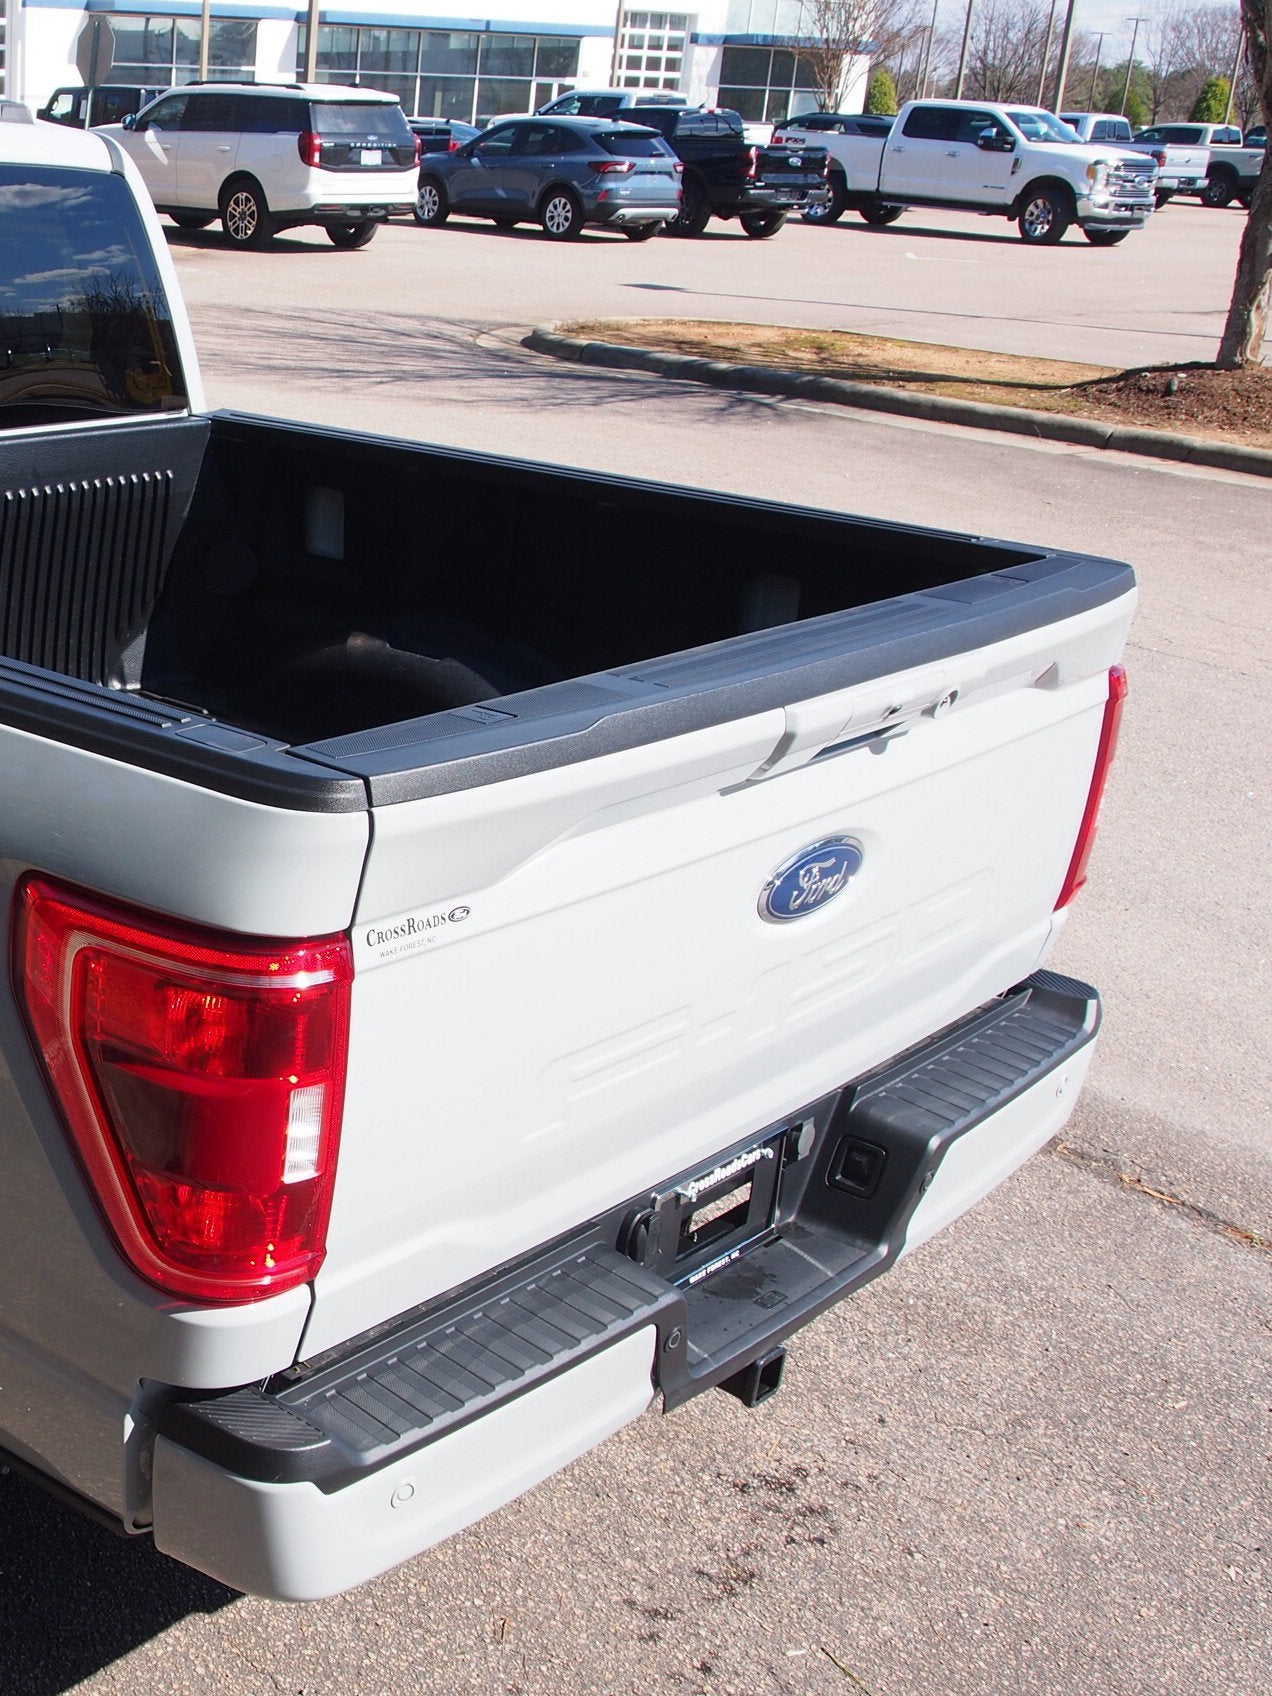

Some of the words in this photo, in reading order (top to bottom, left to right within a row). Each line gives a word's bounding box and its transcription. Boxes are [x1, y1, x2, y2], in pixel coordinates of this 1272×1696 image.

[788, 856, 848, 911] Ford
[379, 946, 399, 958] WAKE
[427, 935, 437, 944] NC
